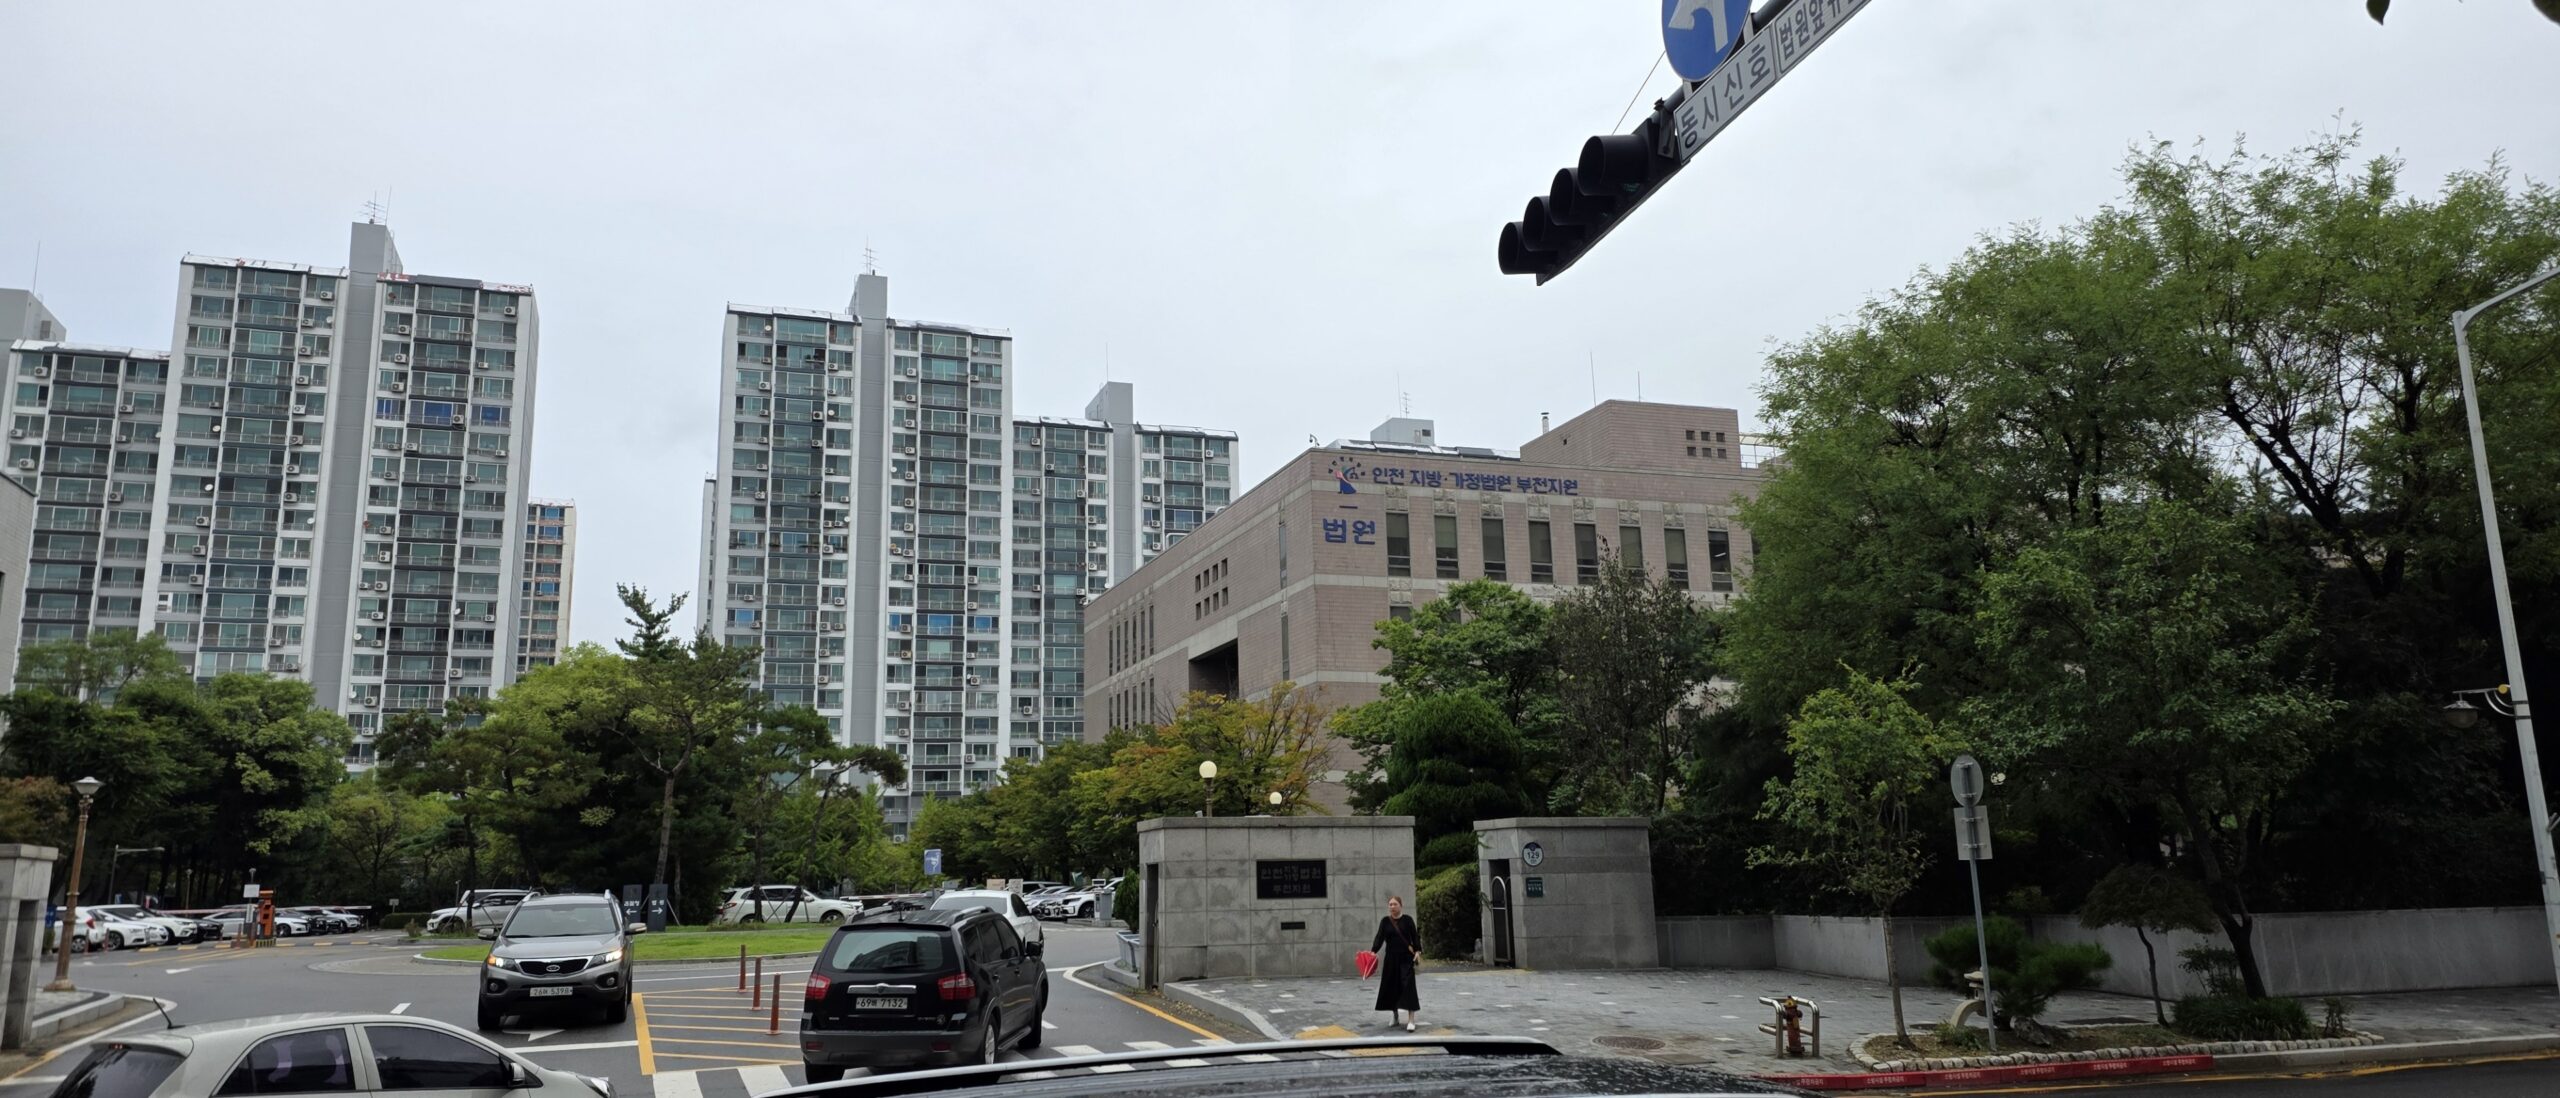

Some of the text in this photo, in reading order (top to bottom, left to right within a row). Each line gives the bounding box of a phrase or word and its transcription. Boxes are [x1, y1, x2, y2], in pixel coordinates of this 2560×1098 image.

[1681, 42, 1770, 149] 동시신호
[1372, 467, 1405, 486] 인천
[1516, 476, 1579, 496] 부천지원
[1322, 518, 1376, 545] 법원
[881, 998, 904, 1008] 7132
